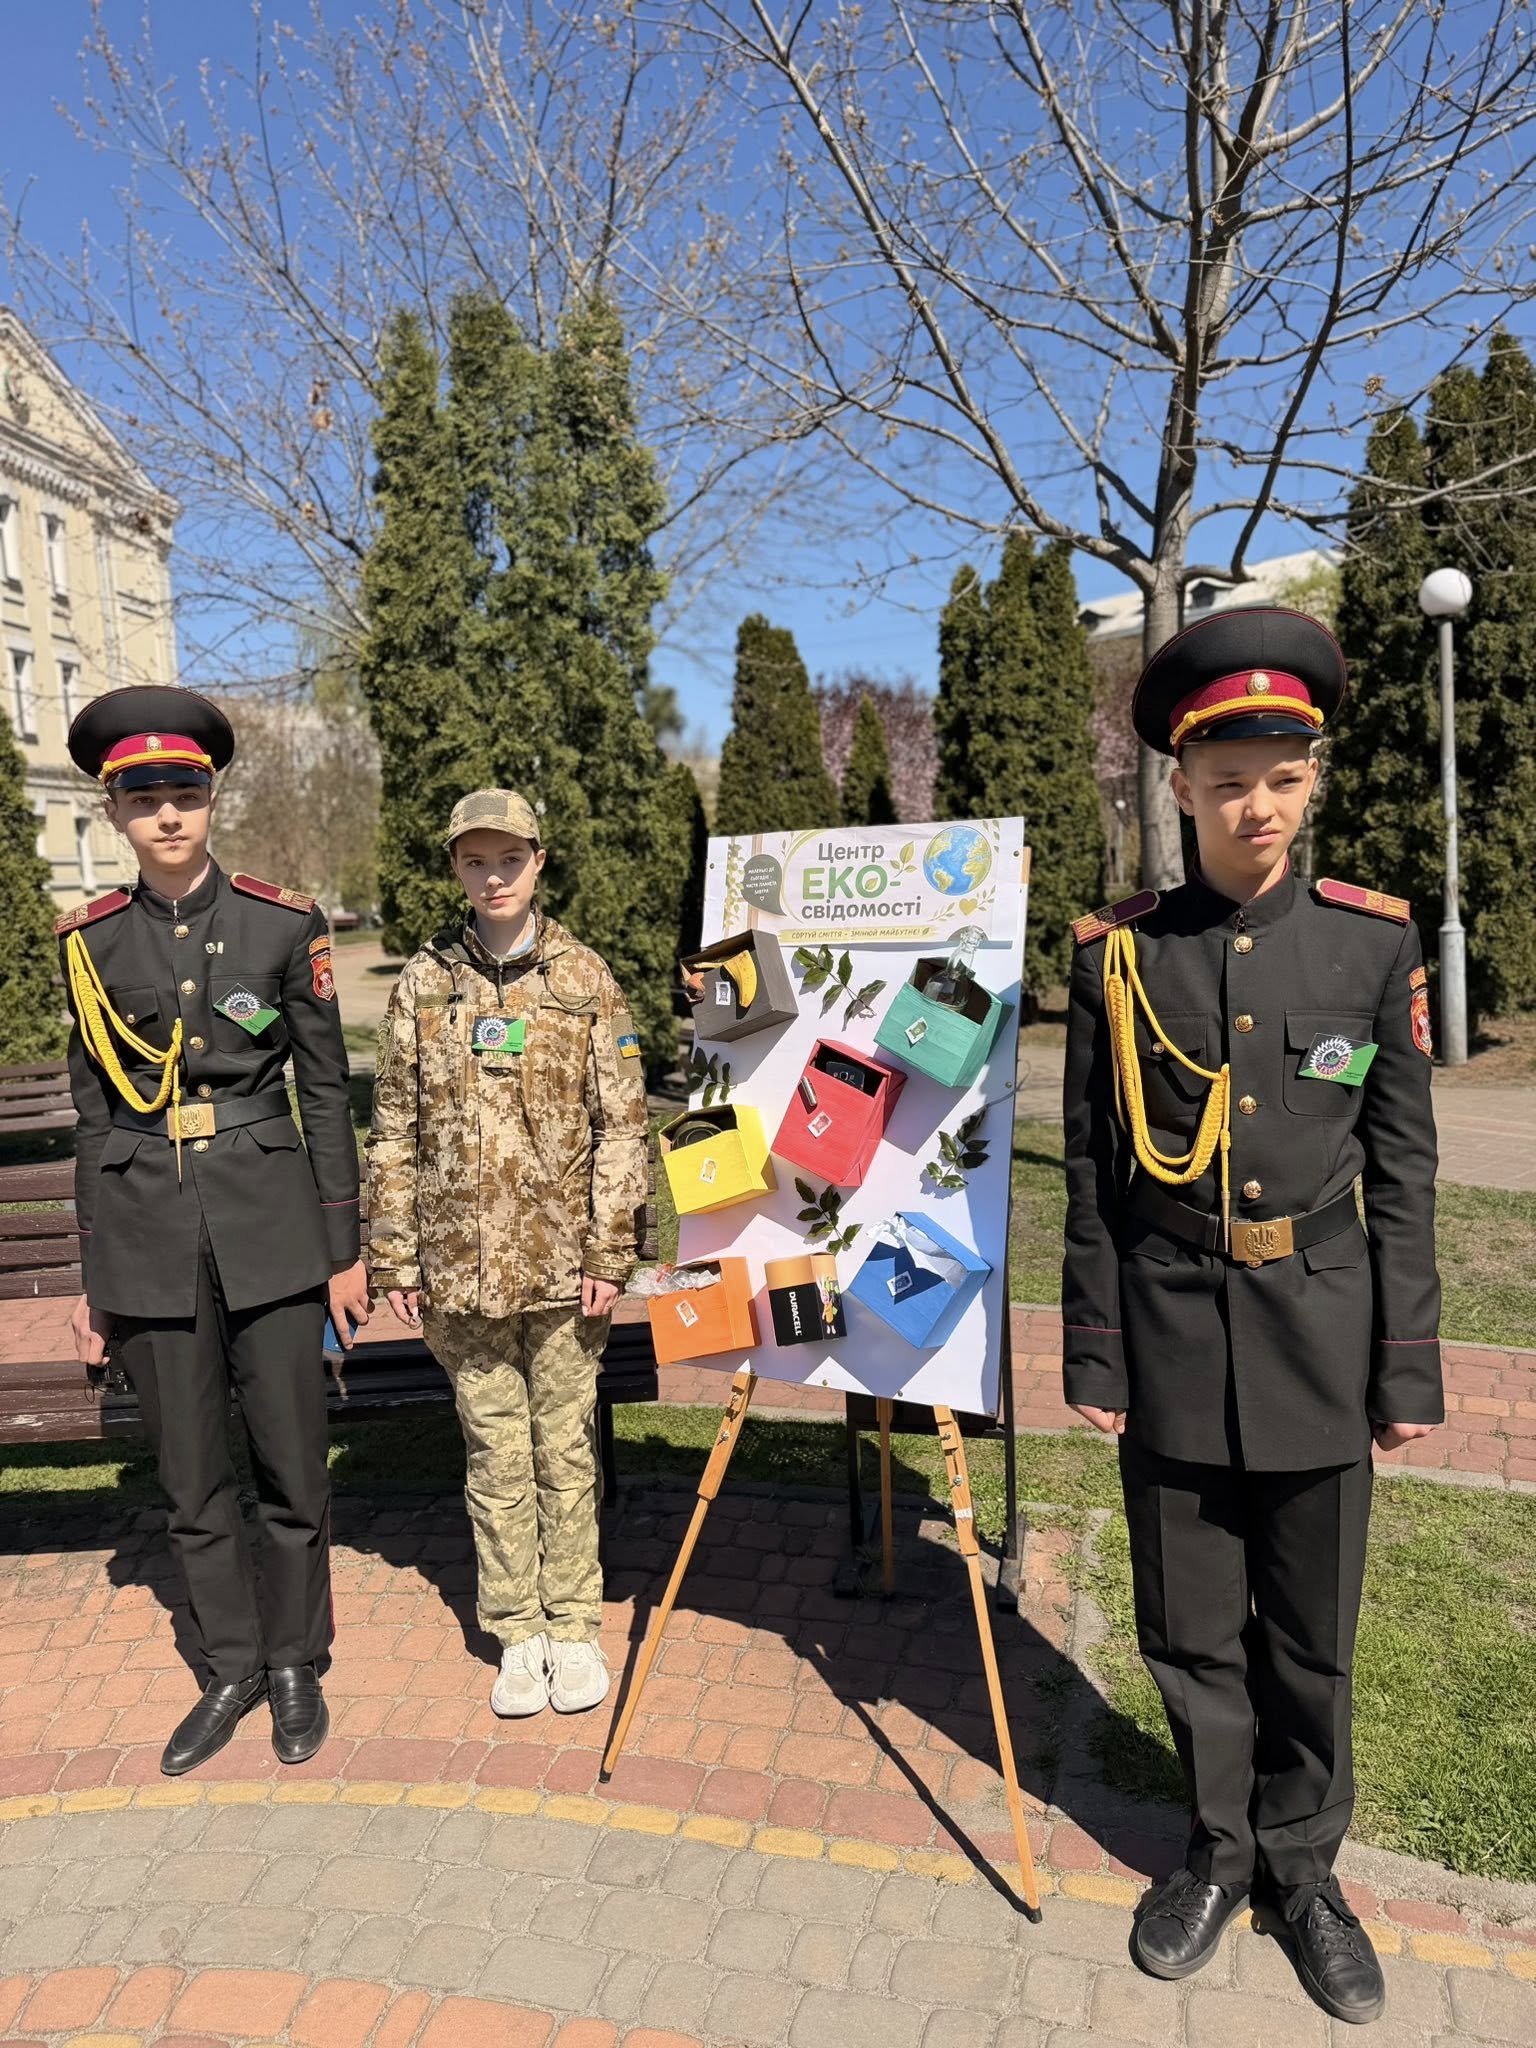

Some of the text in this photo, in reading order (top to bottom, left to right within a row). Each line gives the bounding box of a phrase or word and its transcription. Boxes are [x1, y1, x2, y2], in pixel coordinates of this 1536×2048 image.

[818, 843, 885, 863] Центр
[802, 864, 902, 900] ЕКО-
[801, 897, 922, 922] свідомості
[791, 931, 816, 939] СОРТУЙ
[818, 930, 842, 938] СМІТТЯ
[850, 929, 878, 937] ЗМІНЮЙ
[879, 928, 920, 937] МАЙБУТНЄ!
[789, 1291, 802, 1336] DURACELL
